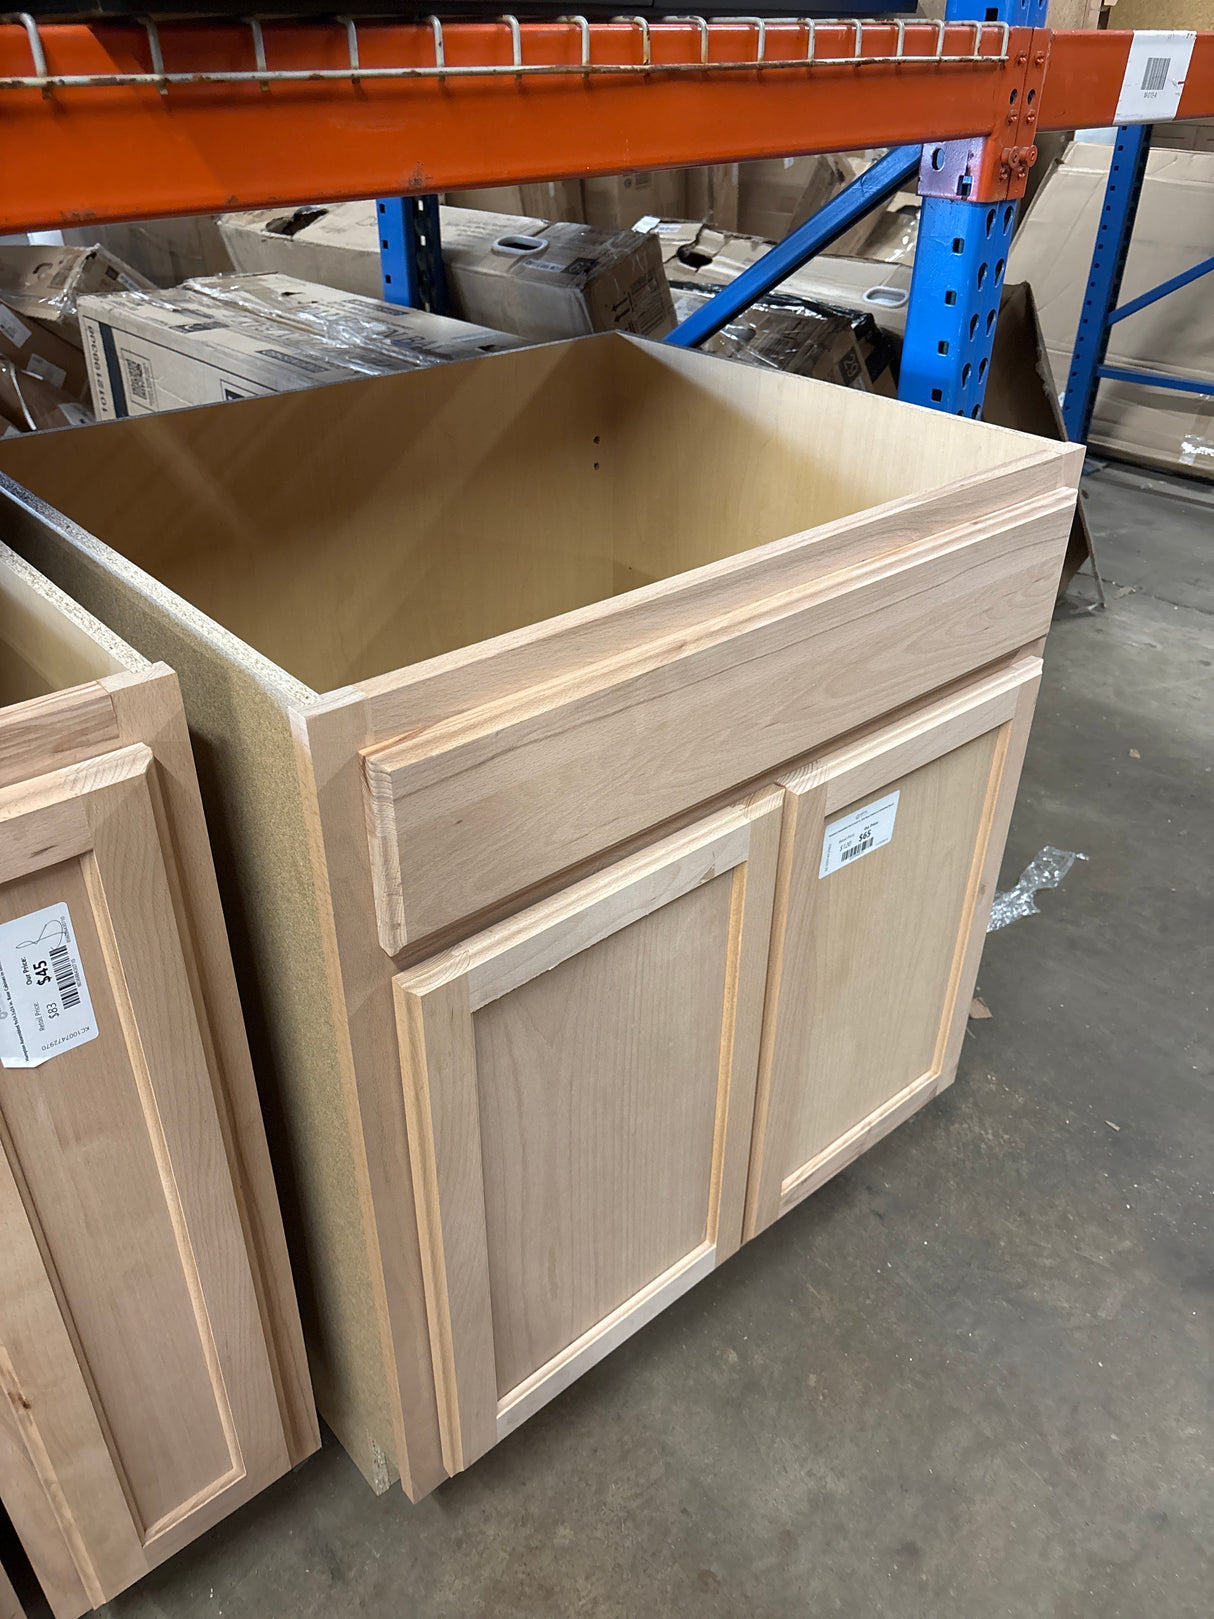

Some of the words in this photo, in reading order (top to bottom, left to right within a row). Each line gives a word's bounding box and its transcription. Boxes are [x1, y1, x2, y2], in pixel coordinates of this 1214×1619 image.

[859, 829, 872, 843] $65
[20, 957, 31, 974] Price:
[33, 960, 52, 986] $45
[25, 974, 33, 986] Our
[33, 1001, 41, 1016] Price:
[47, 1002, 60, 1019] $83
[37, 1015, 45, 1032] Retail
